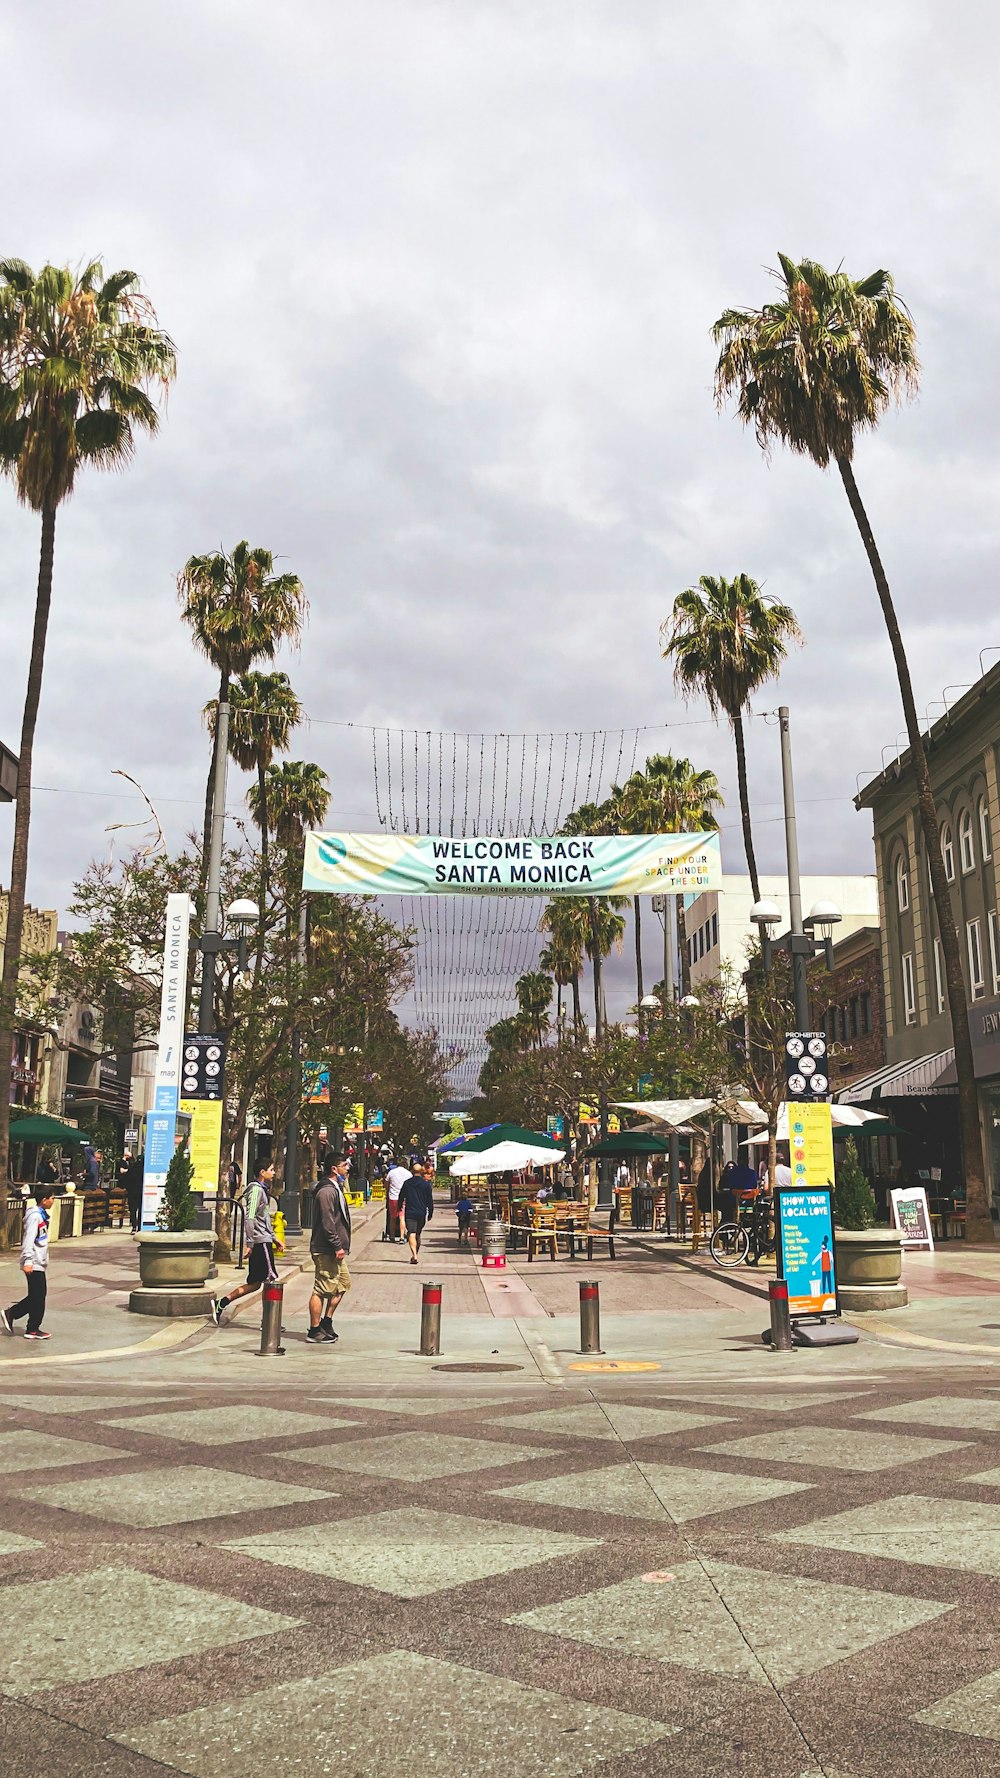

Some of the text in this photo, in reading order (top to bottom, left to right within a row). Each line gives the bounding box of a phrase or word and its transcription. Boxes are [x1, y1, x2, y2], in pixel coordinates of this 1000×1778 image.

[433, 841, 595, 860] WELCOME BACK
[659, 856, 707, 865] FIND YOUR
[435, 865, 593, 883] SANTA MONICA
[645, 866, 708, 876] SPACE UNDER
[670, 876, 709, 886] THE SUN
[167, 914, 182, 1021] SANTA MONICA
[983, 1012, 1000, 1034] JEW
[785, 1031, 826, 1039] PROHIBITED
[160, 1070, 176, 1078] map
[782, 1195, 826, 1206] SHOW YOUR
[782, 1206, 828, 1217] LOCAL LOVE
